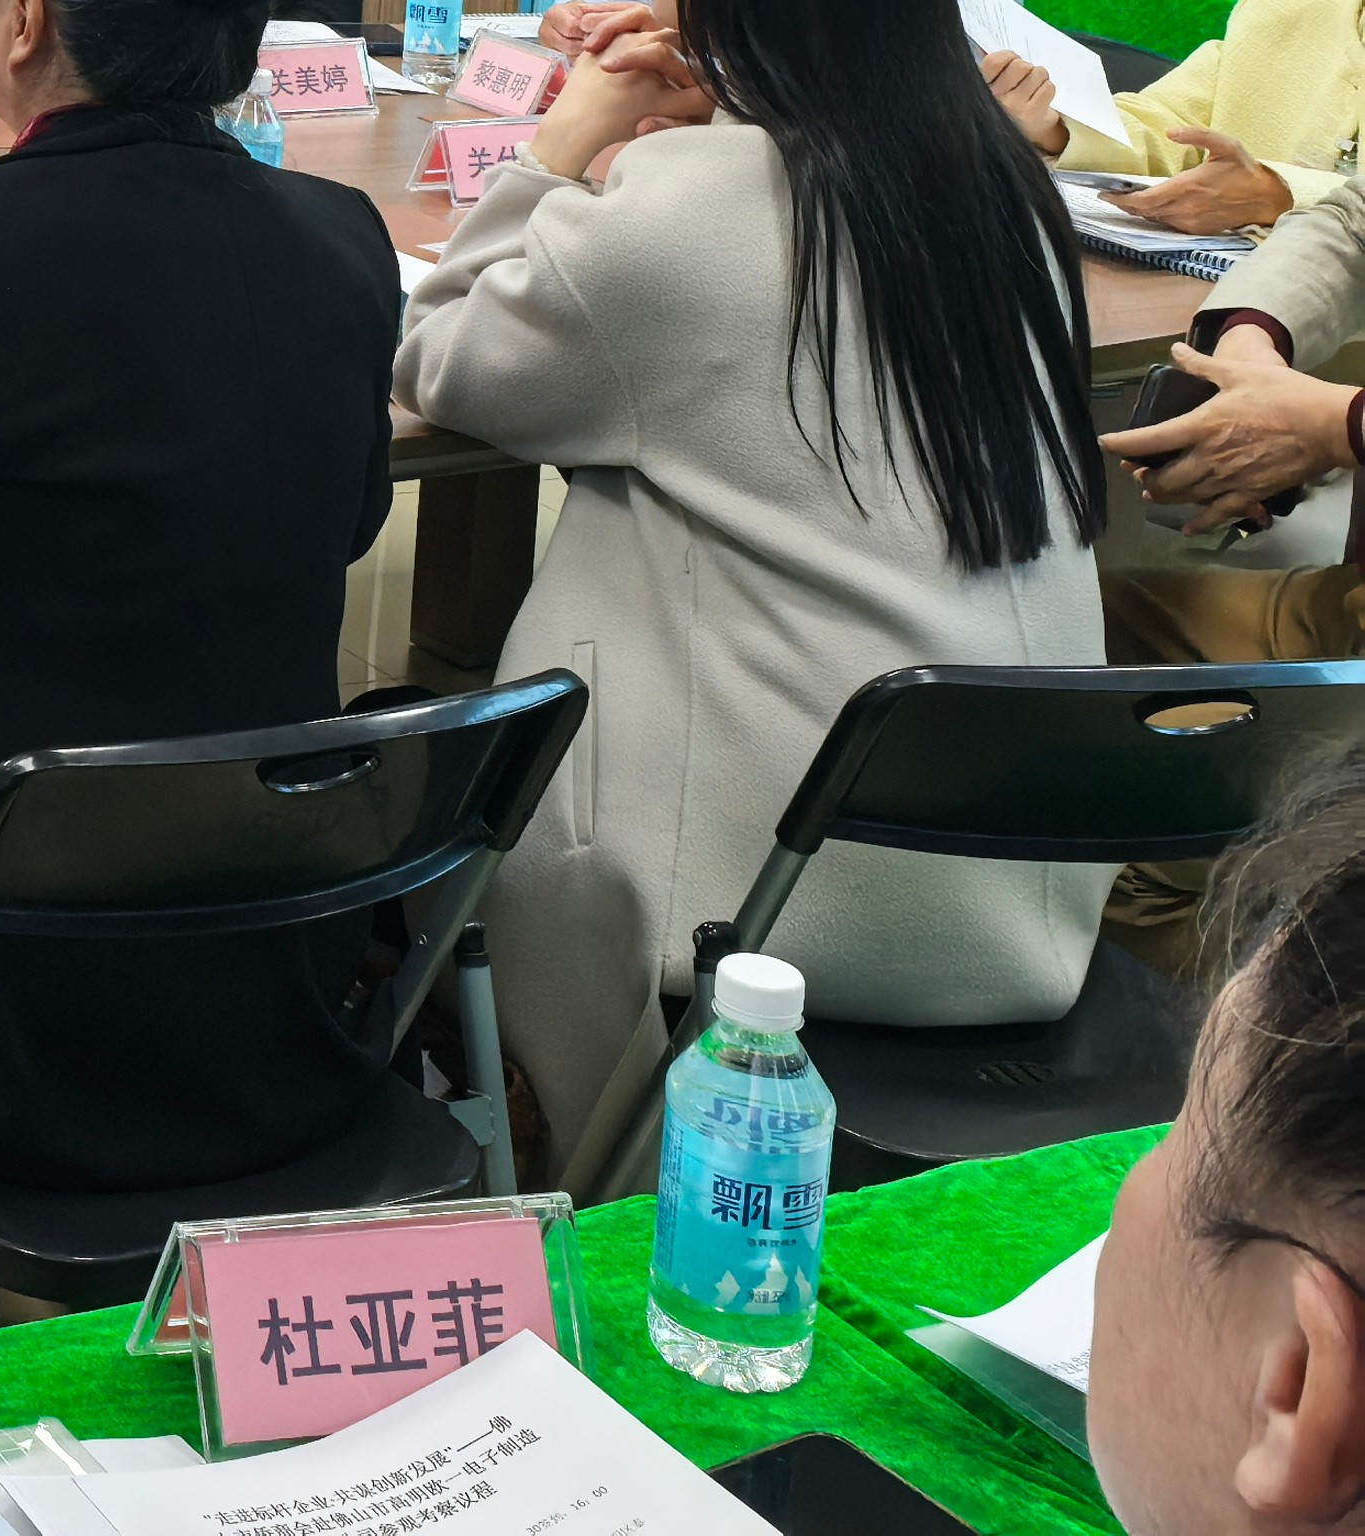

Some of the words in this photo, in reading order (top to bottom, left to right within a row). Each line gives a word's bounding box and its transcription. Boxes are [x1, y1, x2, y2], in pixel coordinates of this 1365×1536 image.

[270, 64, 349, 97] 关美婷
[711, 1173, 823, 1230] 飘雪
[259, 1278, 504, 1386] 杜亚菲
[219, 1428, 542, 1536] 市侨商会赴佛山市高明欧一电子制造
[341, 1480, 498, 1536] 司参观考察议程
